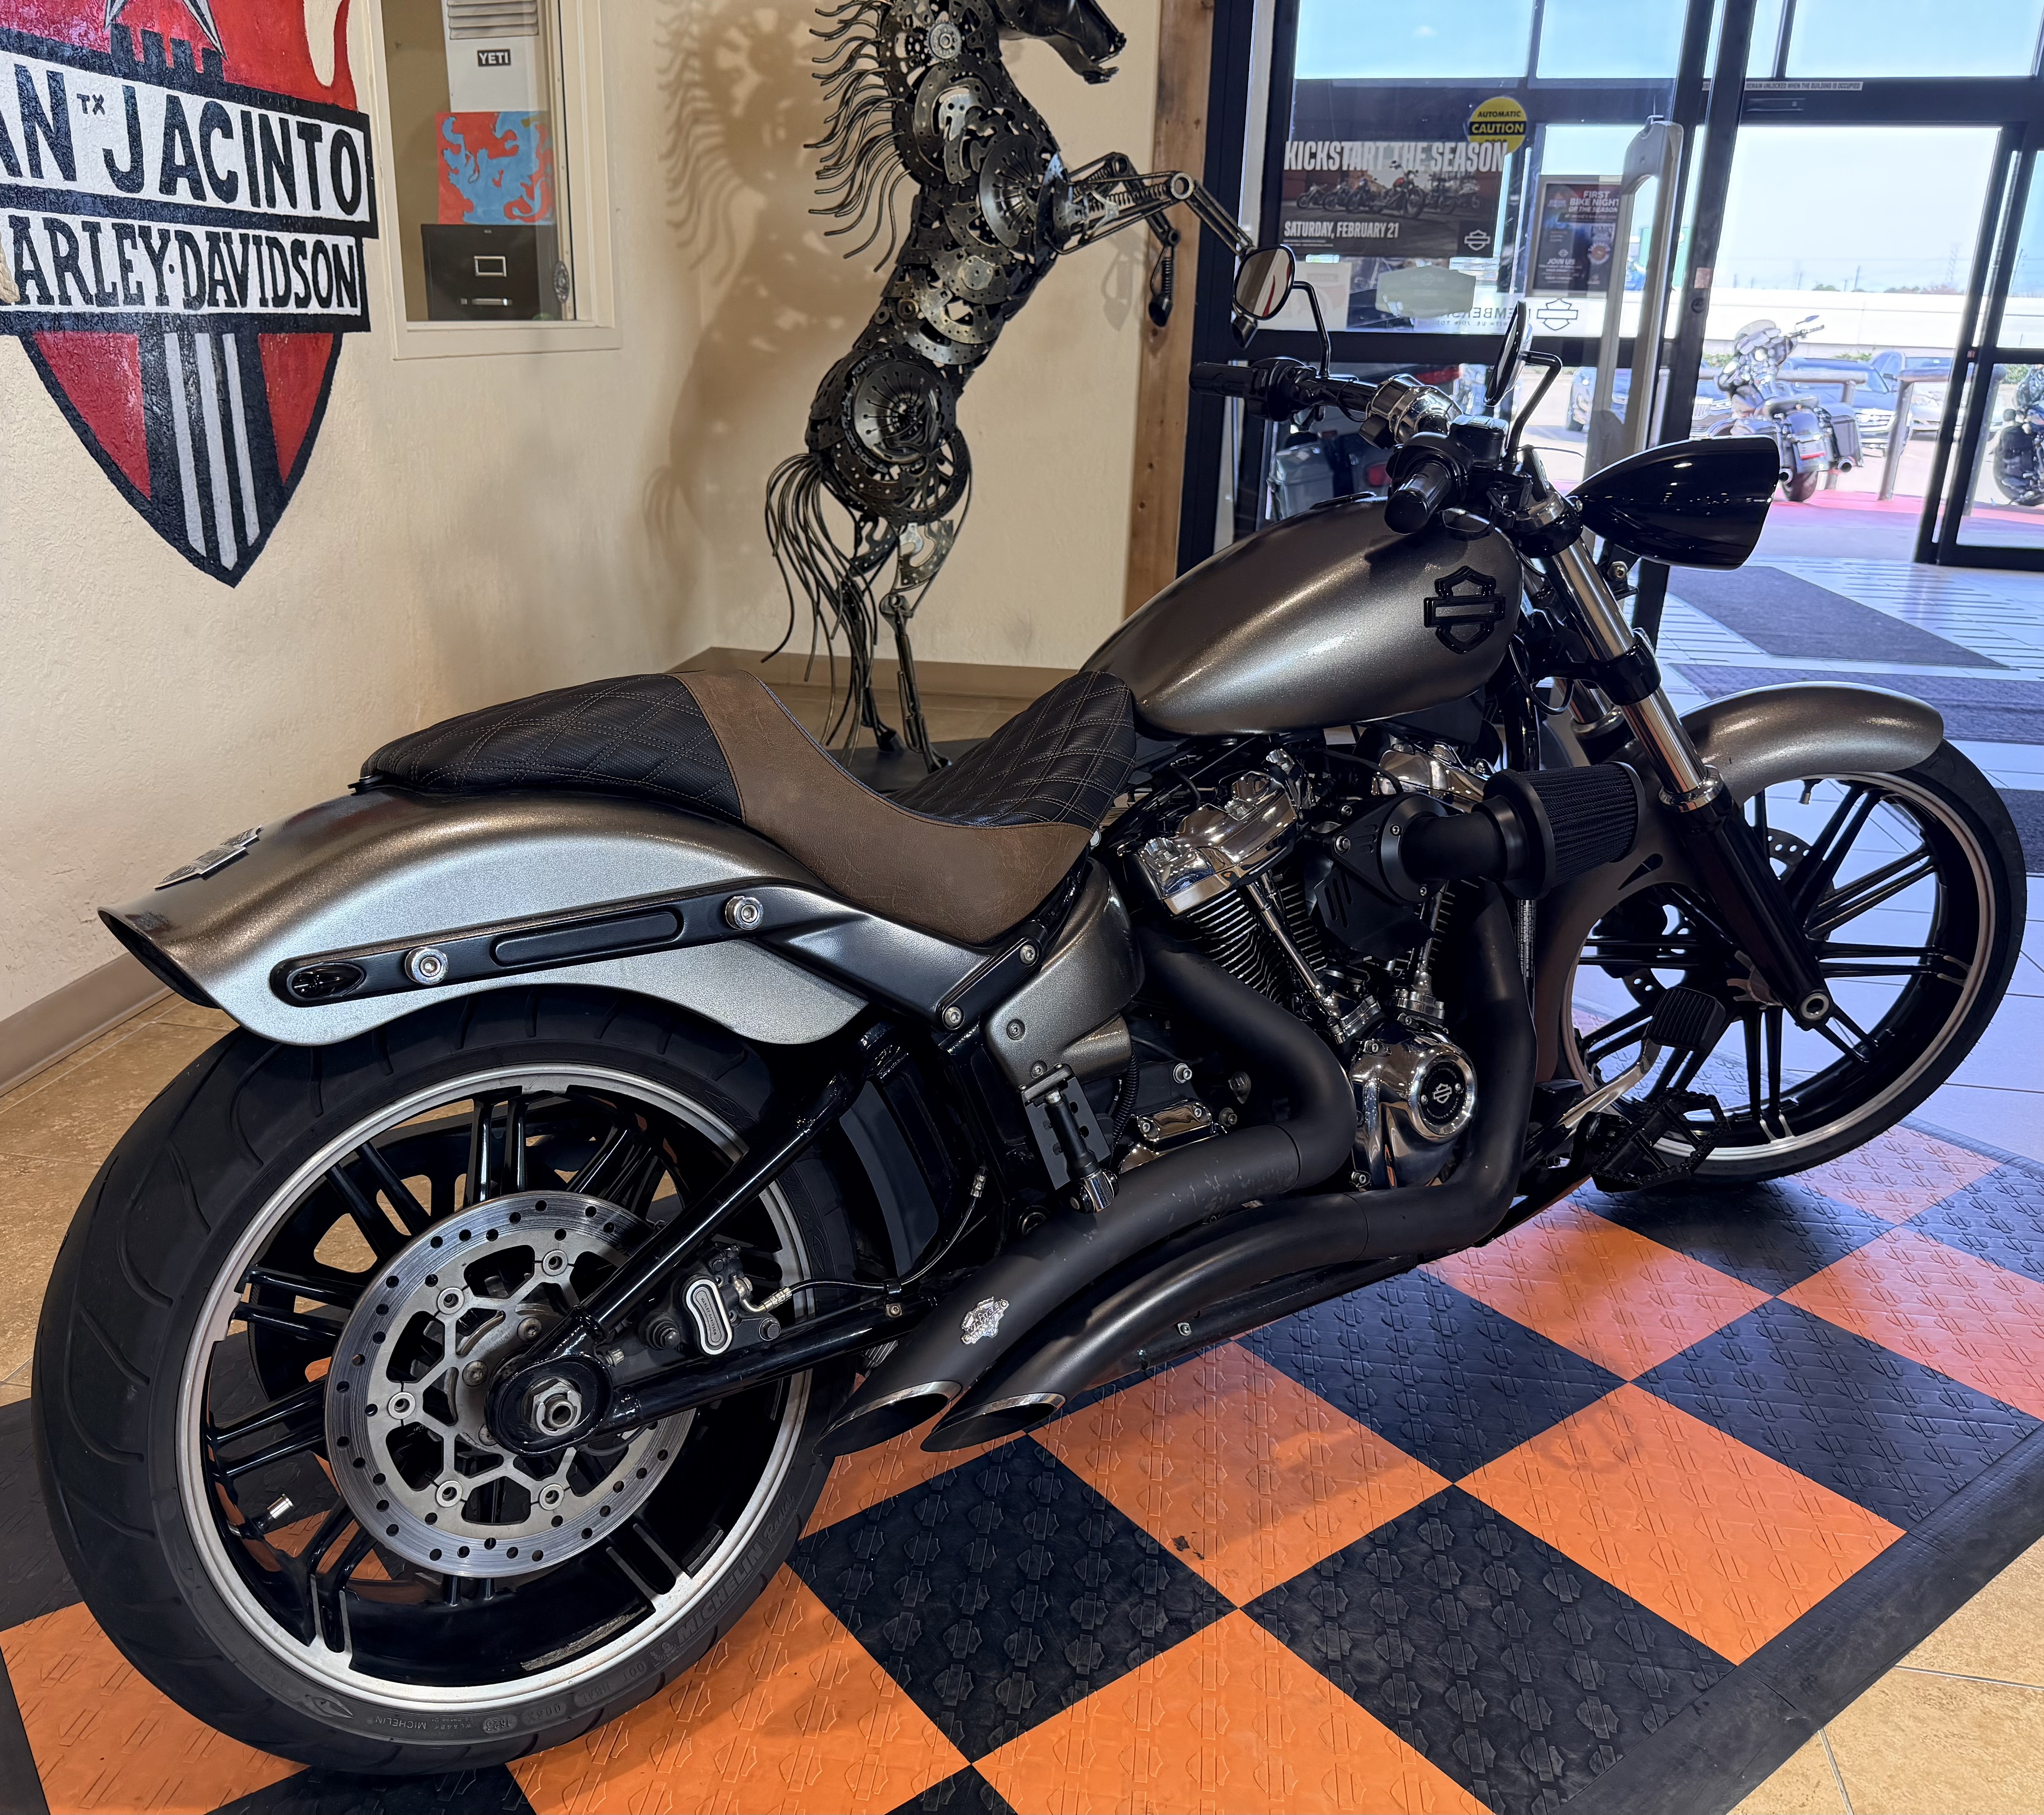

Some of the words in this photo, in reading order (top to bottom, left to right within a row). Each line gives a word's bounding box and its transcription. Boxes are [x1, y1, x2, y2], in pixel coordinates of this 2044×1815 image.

[479, 51, 508, 65] YETI
[1472, 123, 1524, 133] CAUTION
[77, 93, 106, 116] TX
[102, 85, 363, 216] JACINTO
[1284, 141, 1390, 171] KICKSTART
[1391, 142, 1429, 171] THE
[1430, 142, 1508, 172] SEASON
[1569, 198, 1591, 206] BIKE
[1283, 221, 1335, 239] SATURDAY,
[1336, 222, 1387, 238] FEBRUARY
[1387, 222, 1400, 238] 21
[677, 1543, 764, 1642] MICHELIN
[764, 1493, 795, 1543] Radial
[375, 1715, 427, 1730] MICHELIN
